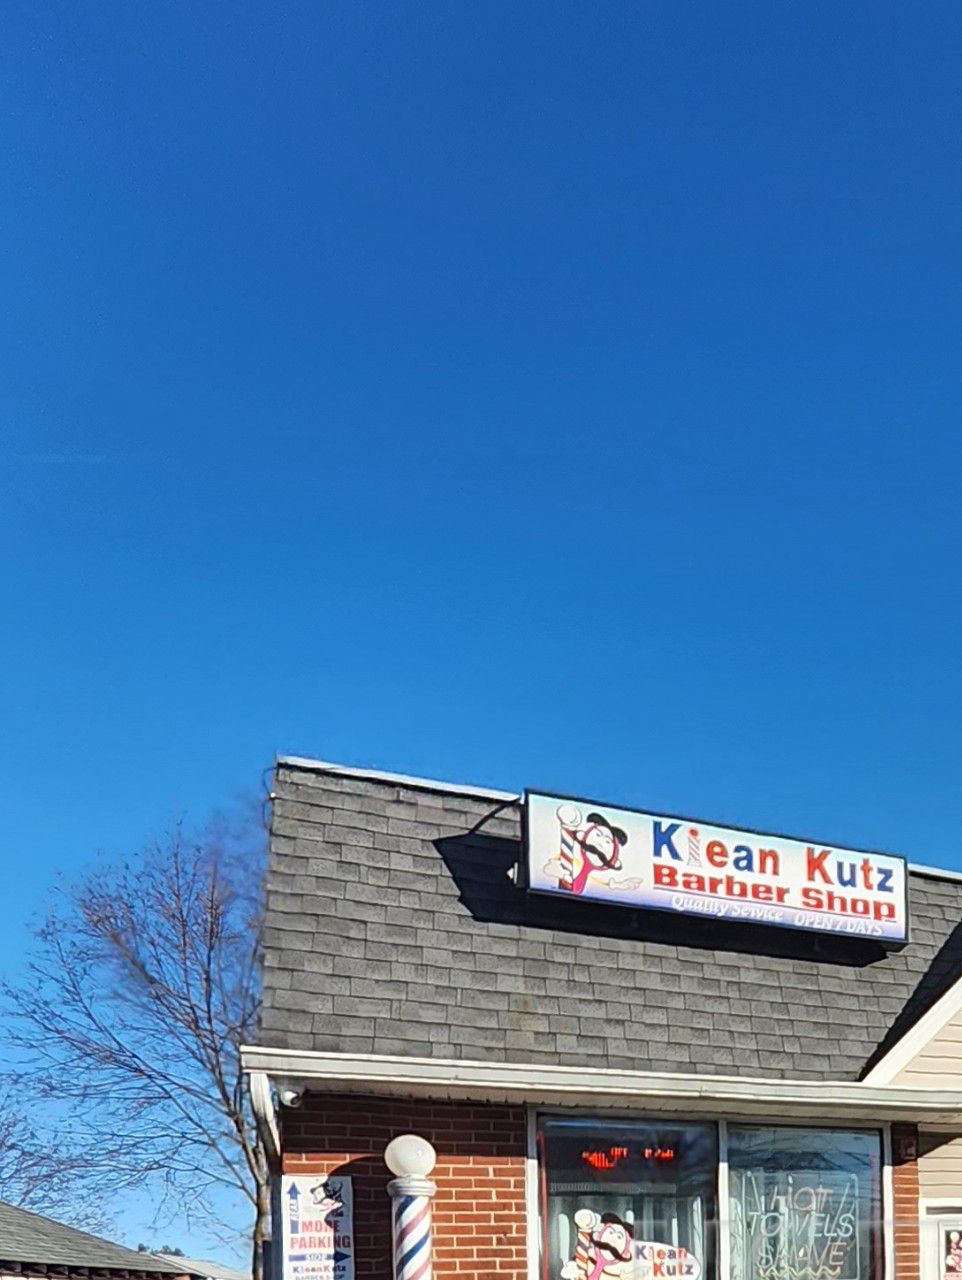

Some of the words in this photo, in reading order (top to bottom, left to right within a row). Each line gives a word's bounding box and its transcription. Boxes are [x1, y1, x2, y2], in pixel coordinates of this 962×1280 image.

[653, 820, 780, 876] Klean
[805, 846, 894, 894] Kutz
[653, 863, 791, 904] Barber
[800, 886, 897, 921] Shop
[671, 895, 728, 917] Quality
[731, 902, 784, 924] Service
[793, 912, 834, 931] OPEN
[834, 916, 843, 931] 7
[845, 918, 883, 936] DAYS
[301, 1219, 340, 1233] MORE
[748, 1211, 855, 1238] TOWELS
[290, 1235, 352, 1249] PARKING
[635, 1245, 689, 1261] Klean
[652, 1262, 694, 1278] Kutz
